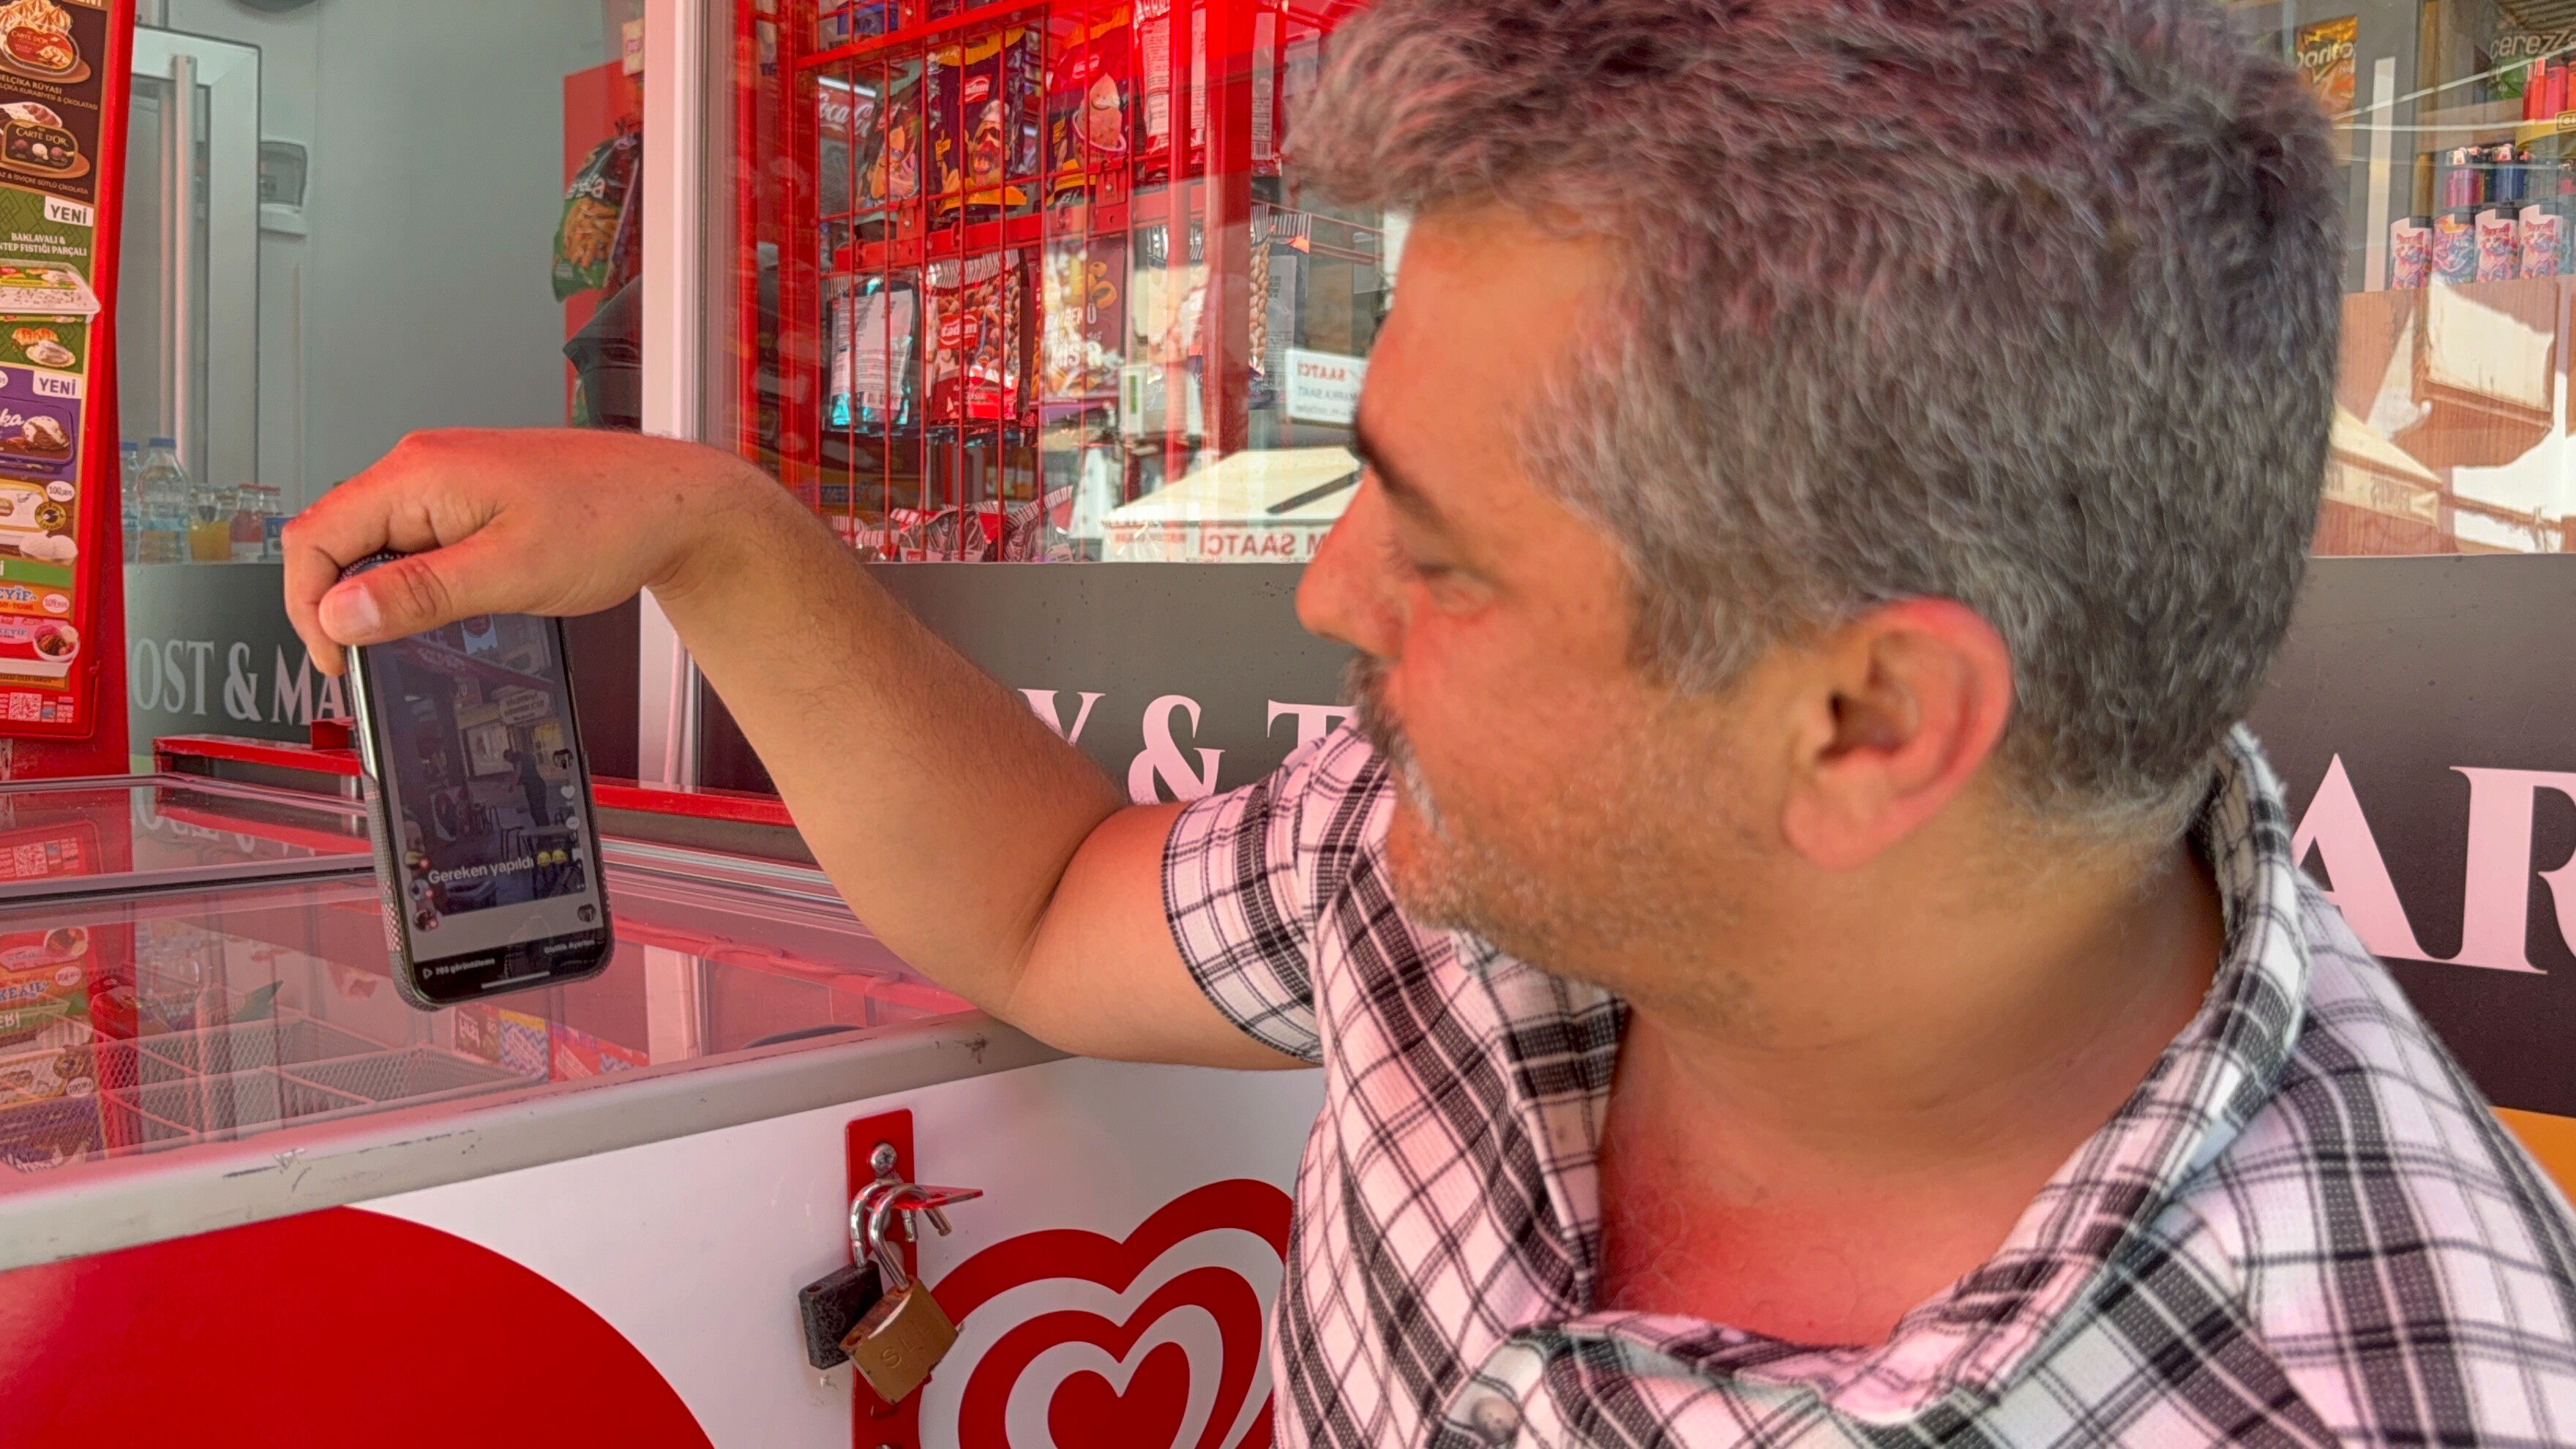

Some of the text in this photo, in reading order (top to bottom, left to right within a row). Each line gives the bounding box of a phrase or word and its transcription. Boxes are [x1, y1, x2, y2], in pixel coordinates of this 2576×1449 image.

[50, 204, 88, 224] YENİ
[11, 232, 59, 244] BAKLAVALI
[40, 377, 76, 396] YENİ
[223, 642, 262, 722] &
[1128, 694, 1225, 805] &
[428, 856, 534, 884] Gereken yapıldı
